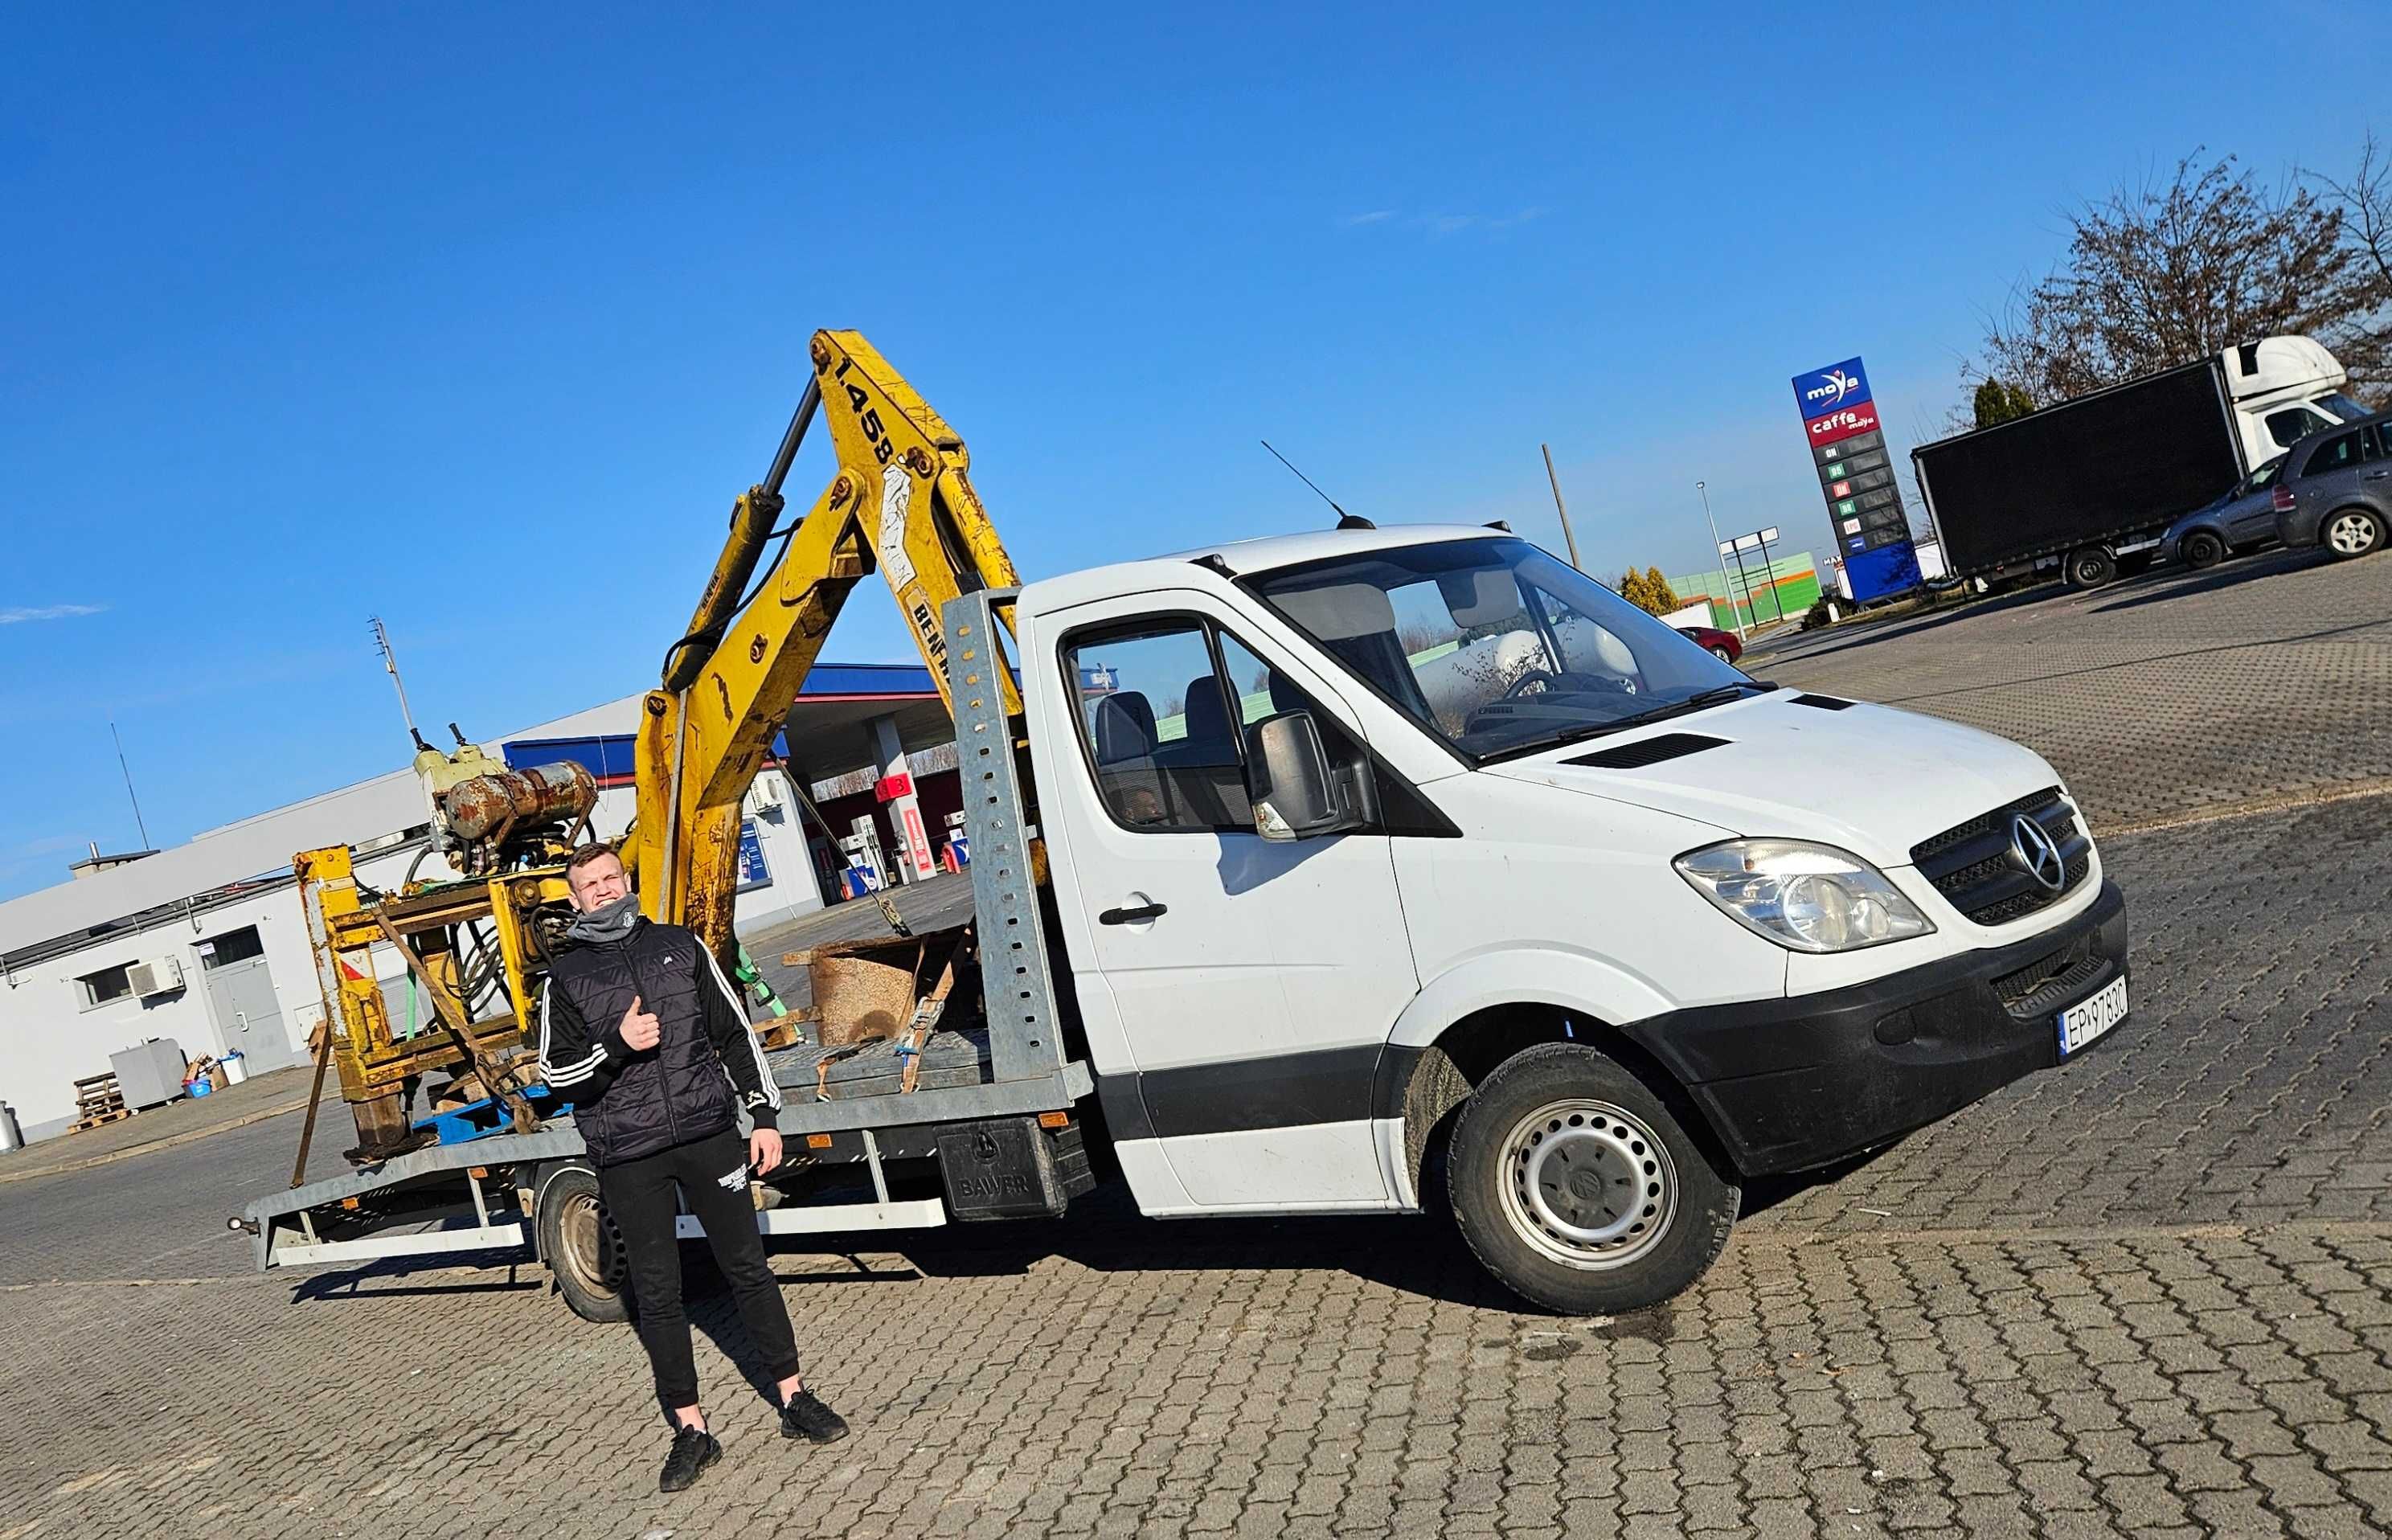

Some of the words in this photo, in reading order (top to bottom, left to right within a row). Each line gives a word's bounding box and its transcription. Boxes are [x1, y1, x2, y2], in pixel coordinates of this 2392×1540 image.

[1807, 371, 1859, 403] moya
[1812, 412, 1857, 433] caffe
[1849, 417, 1874, 429] moya
[895, 778, 905, 793] 3
[2068, 1008, 2087, 1047] EP
[2091, 982, 2126, 1034] 9783C
